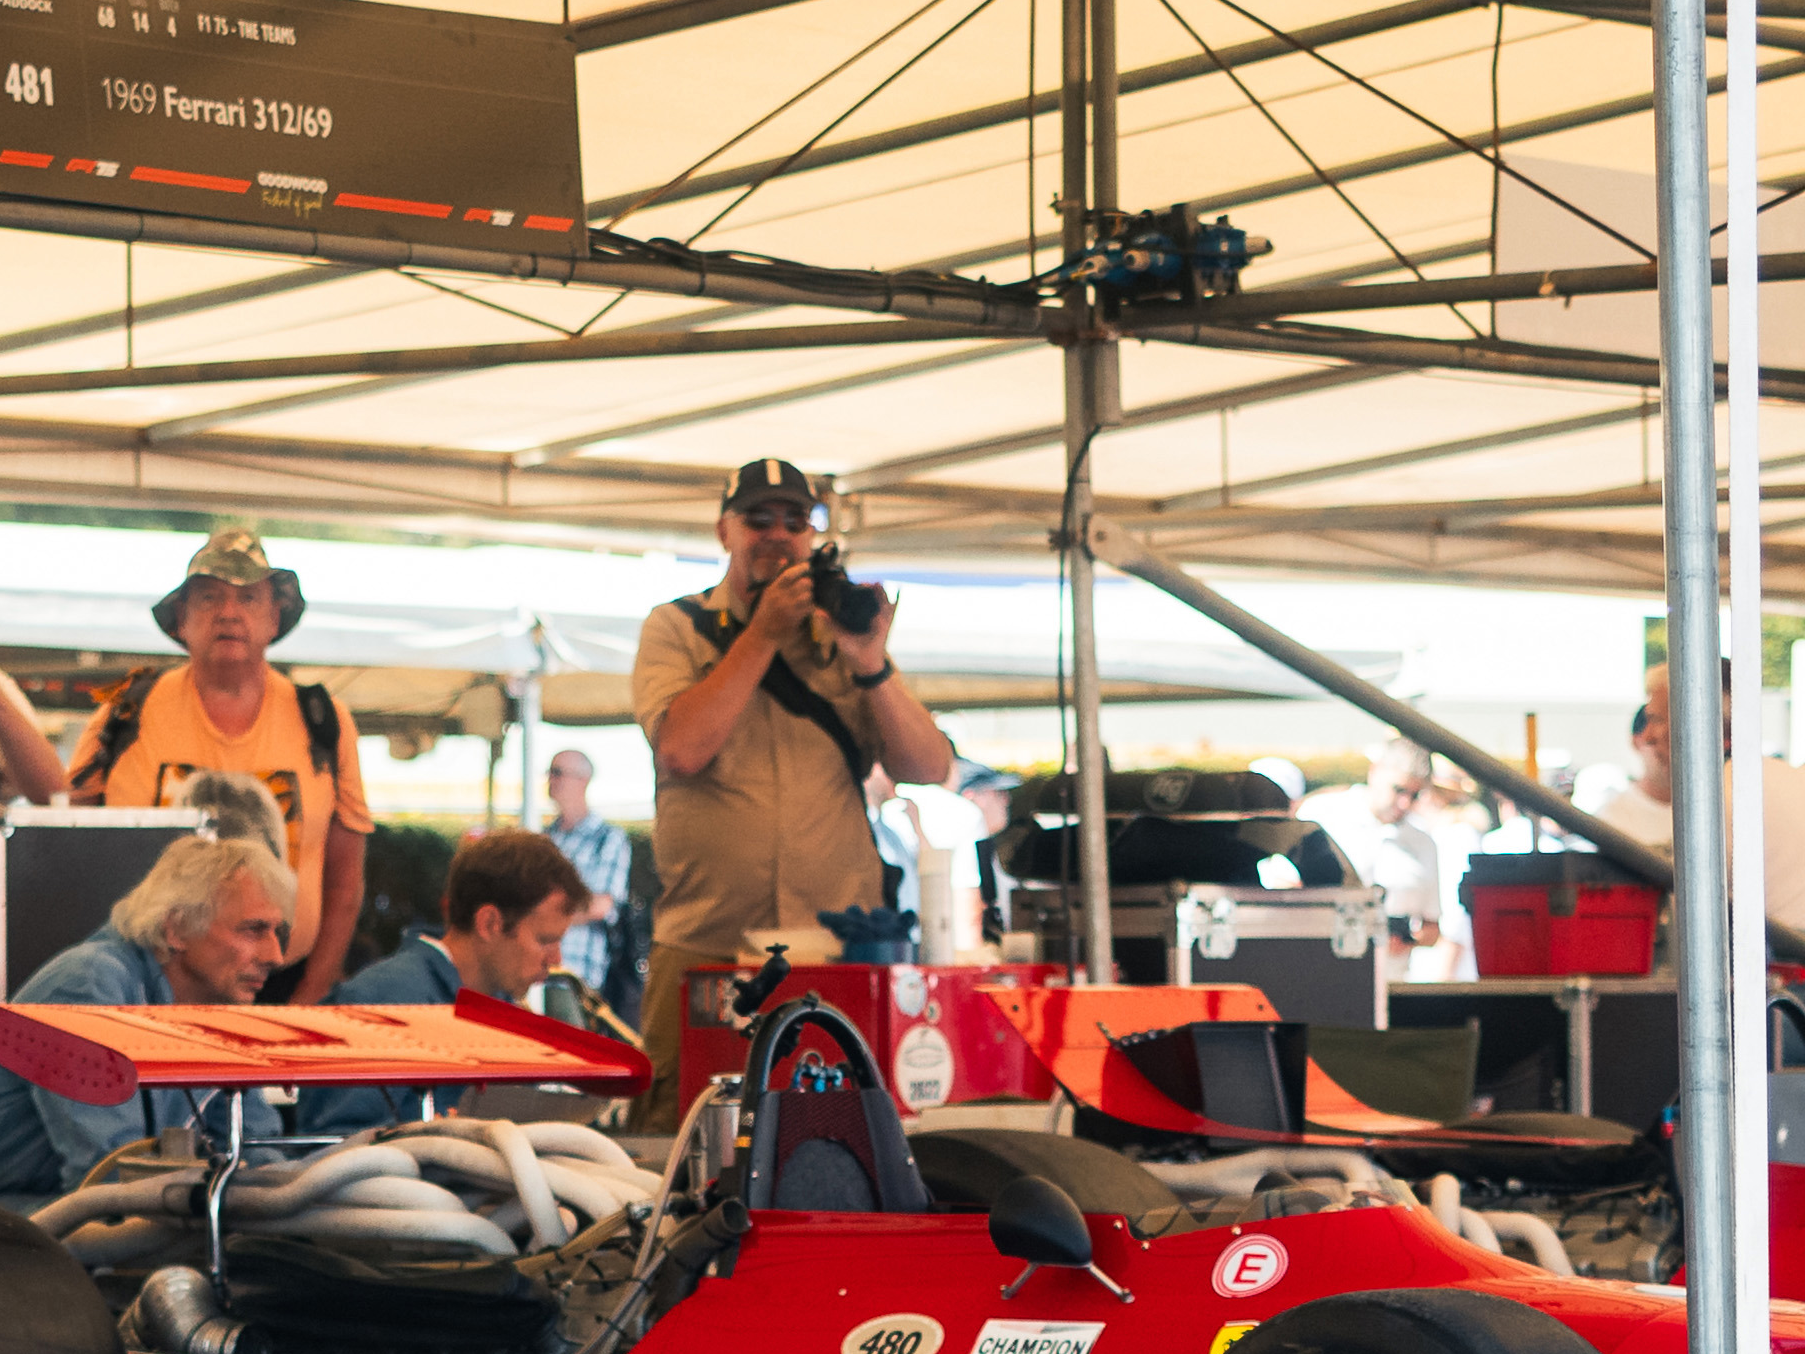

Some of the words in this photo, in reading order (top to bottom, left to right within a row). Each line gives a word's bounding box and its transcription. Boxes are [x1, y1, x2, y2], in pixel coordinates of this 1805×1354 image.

[132, 10, 149, 33] 14
[168, 17, 177, 37] 4
[197, 13, 211, 33] F1
[213, 15, 229, 36] 75
[238, 19, 260, 41] THE
[261, 24, 297, 46] TEAMS
[5, 62, 54, 107] 481
[101, 77, 157, 115] 1969
[164, 86, 247, 129] Ferrari
[253, 97, 333, 139] 312/69
[1233, 1254, 1267, 1284] E
